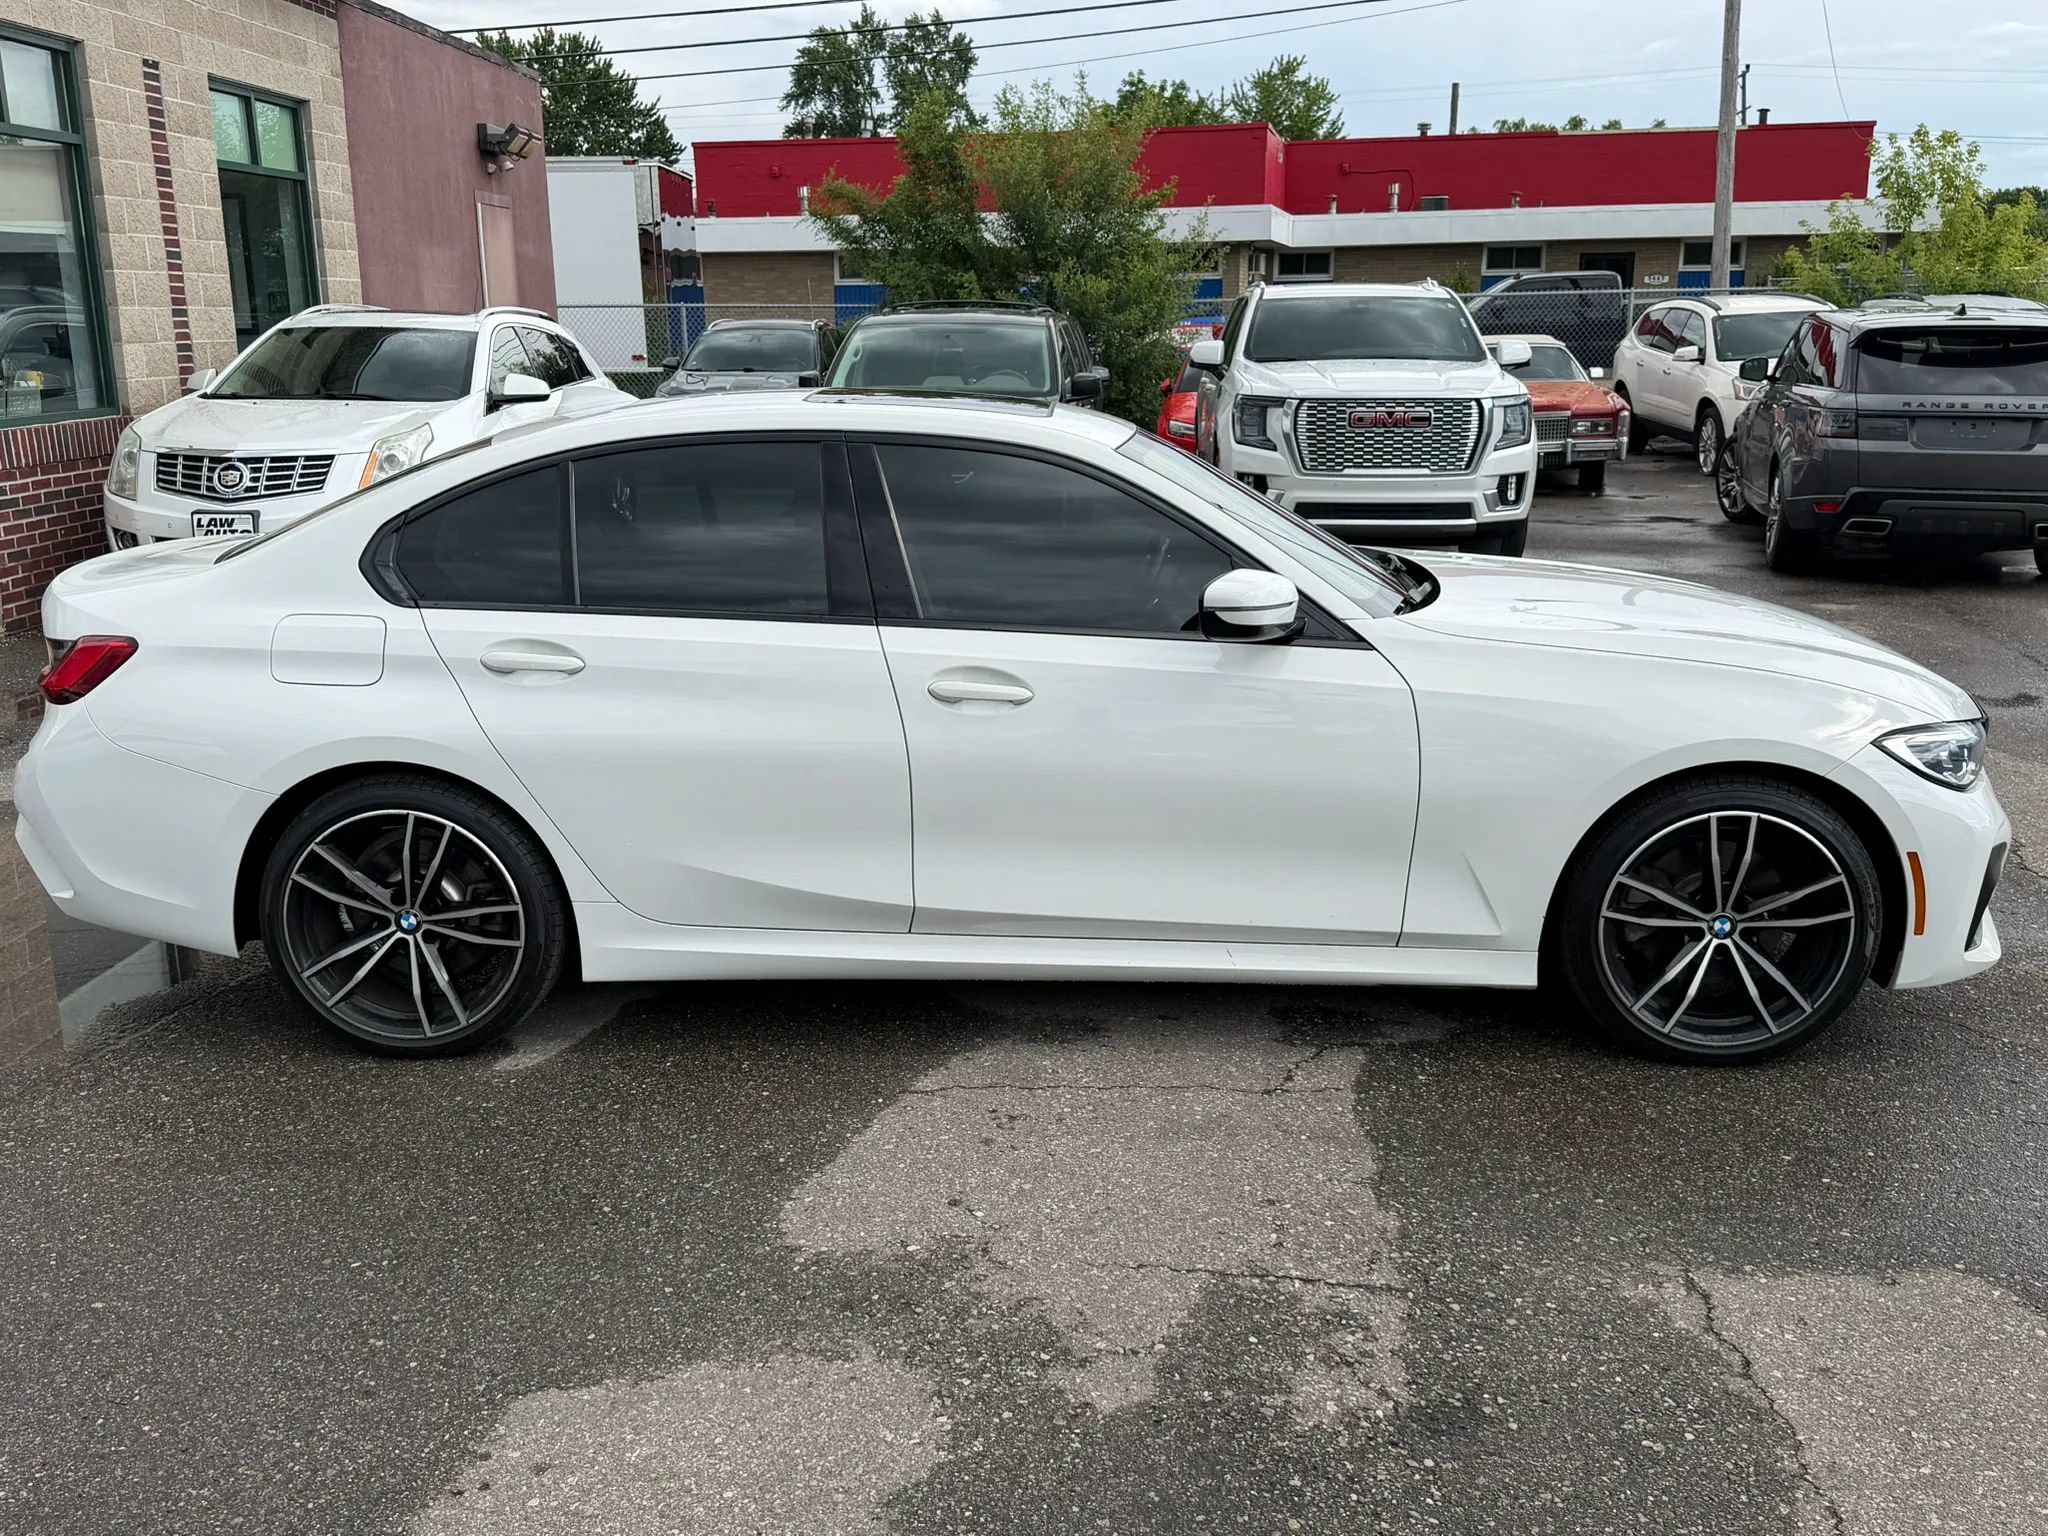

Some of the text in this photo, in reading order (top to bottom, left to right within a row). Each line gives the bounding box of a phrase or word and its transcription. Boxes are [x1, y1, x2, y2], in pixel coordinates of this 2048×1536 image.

[1902, 401, 1970, 409] RANGE
[1351, 412, 1430, 427] GMC
[196, 517, 236, 528] LAW
